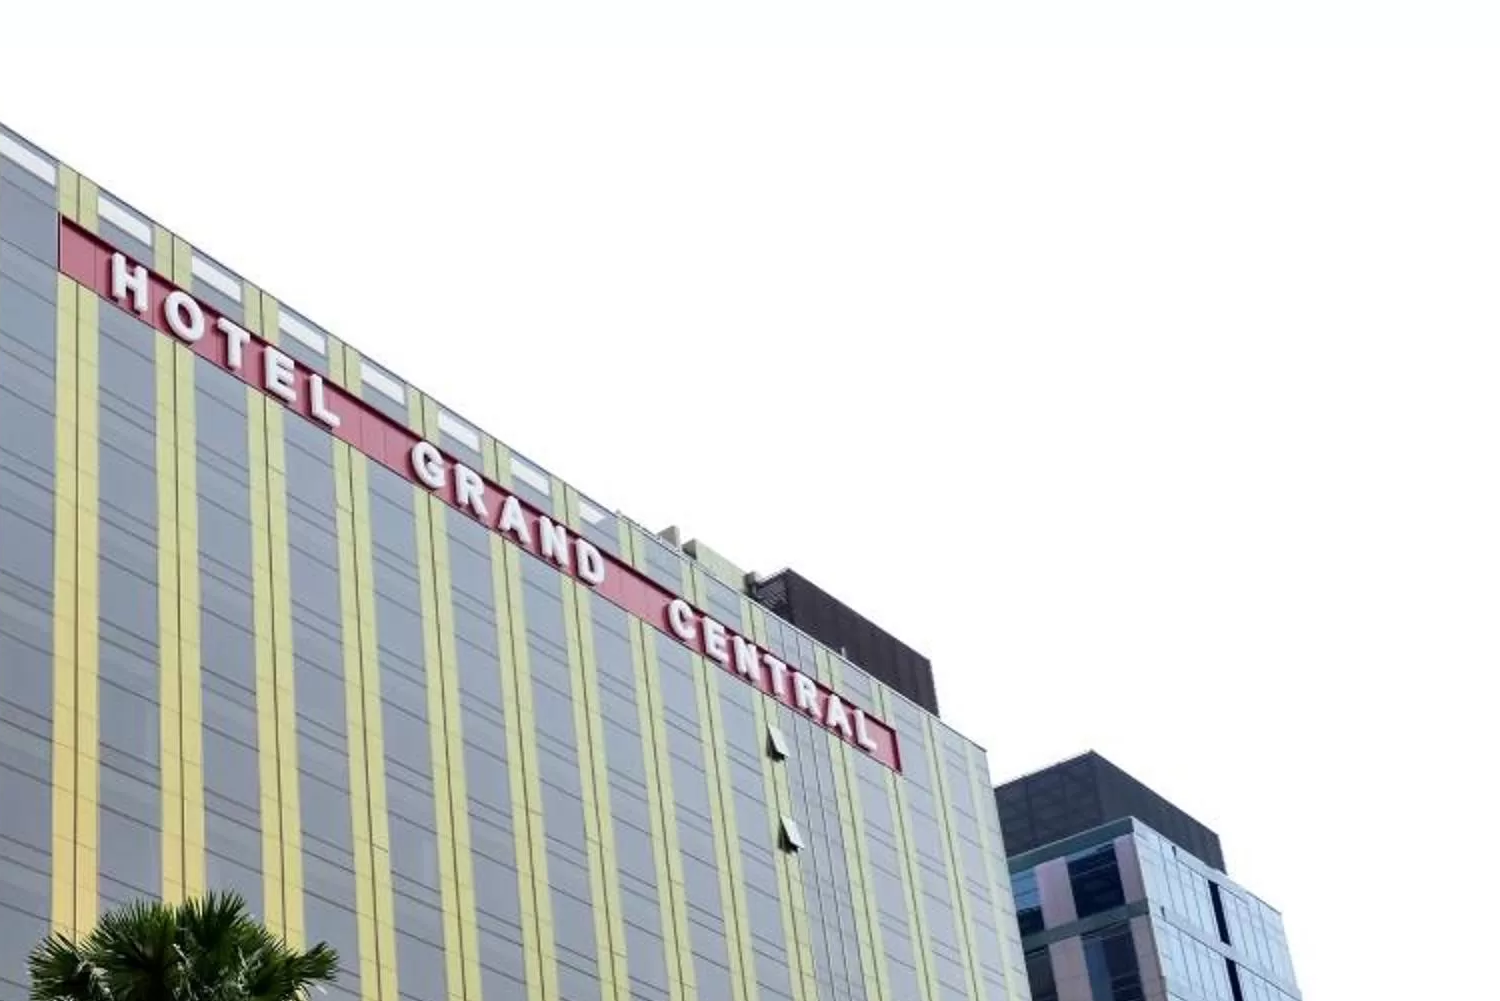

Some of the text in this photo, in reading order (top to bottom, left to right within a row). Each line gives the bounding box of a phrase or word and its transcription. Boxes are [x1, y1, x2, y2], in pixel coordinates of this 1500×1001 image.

[111, 252, 878, 751] HOTEL GRAND CENTRAL
